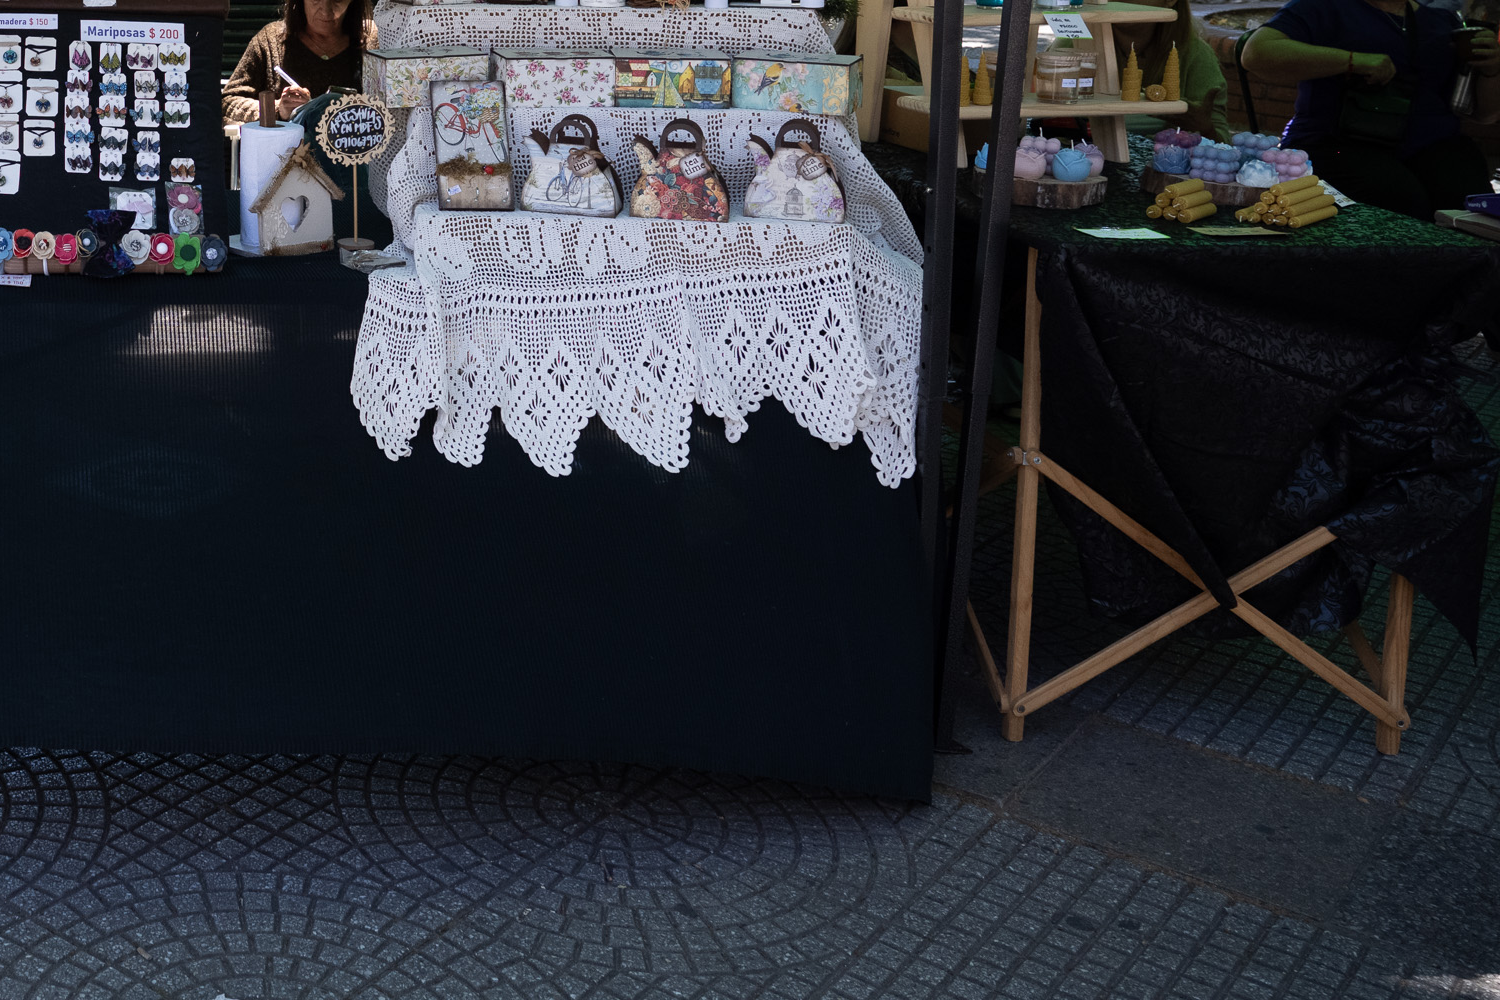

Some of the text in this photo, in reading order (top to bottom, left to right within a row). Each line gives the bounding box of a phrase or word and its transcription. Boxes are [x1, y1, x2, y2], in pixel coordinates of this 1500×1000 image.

[29, 18, 34, 26] $
[36, 18, 49, 26] 150
[87, 25, 179, 40] Mariposas $ 200
[573, 159, 594, 173] time
[684, 157, 699, 168] tea
[684, 162, 706, 177] time
[802, 162, 824, 176] time
